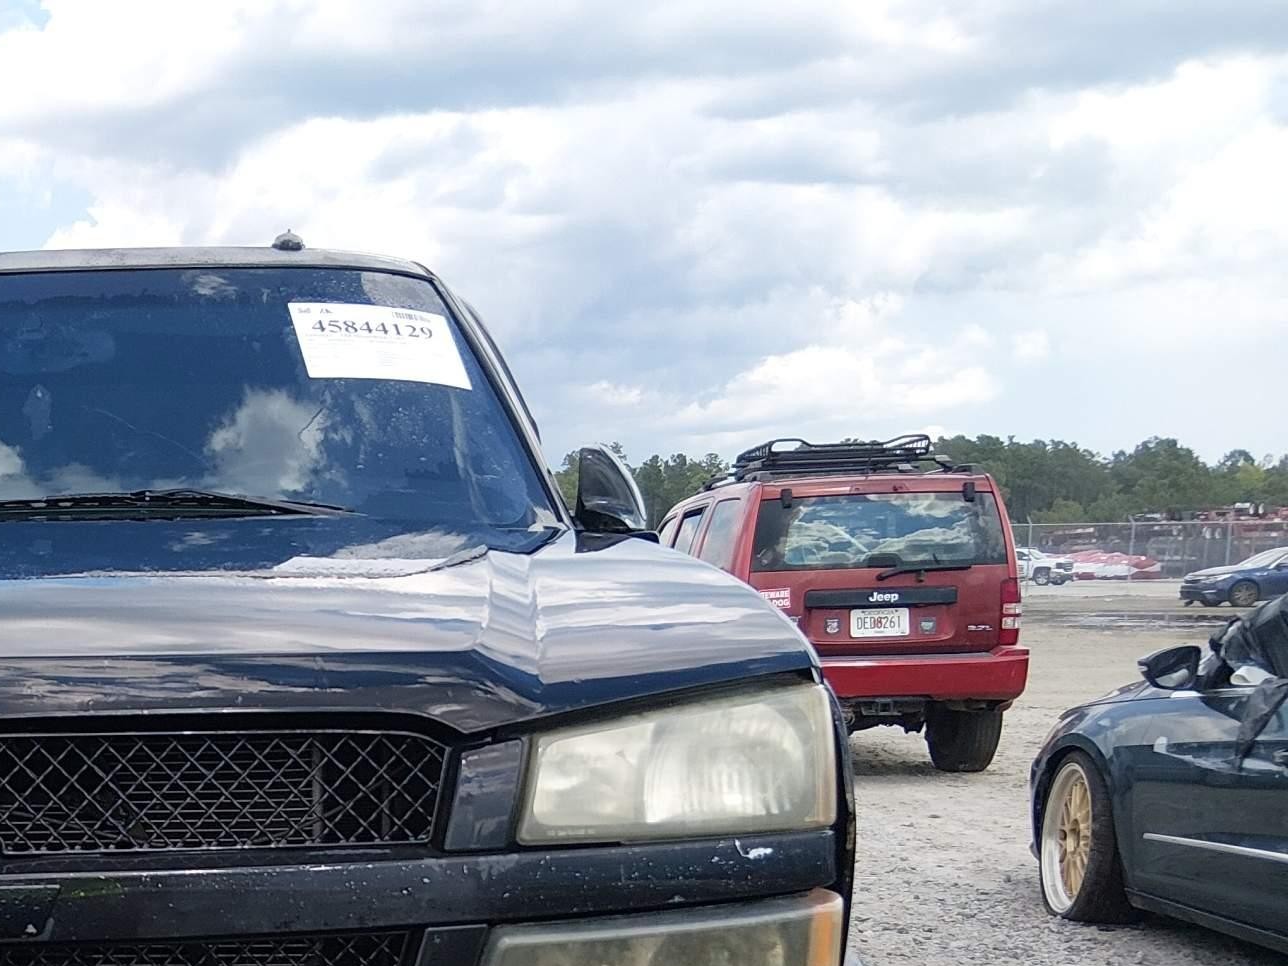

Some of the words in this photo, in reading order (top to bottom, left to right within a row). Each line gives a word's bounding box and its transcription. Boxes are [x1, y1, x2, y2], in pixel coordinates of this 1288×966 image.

[312, 319, 433, 339] 45844129
[868, 592, 899, 602] Jeep
[857, 616, 900, 630] DED8261
